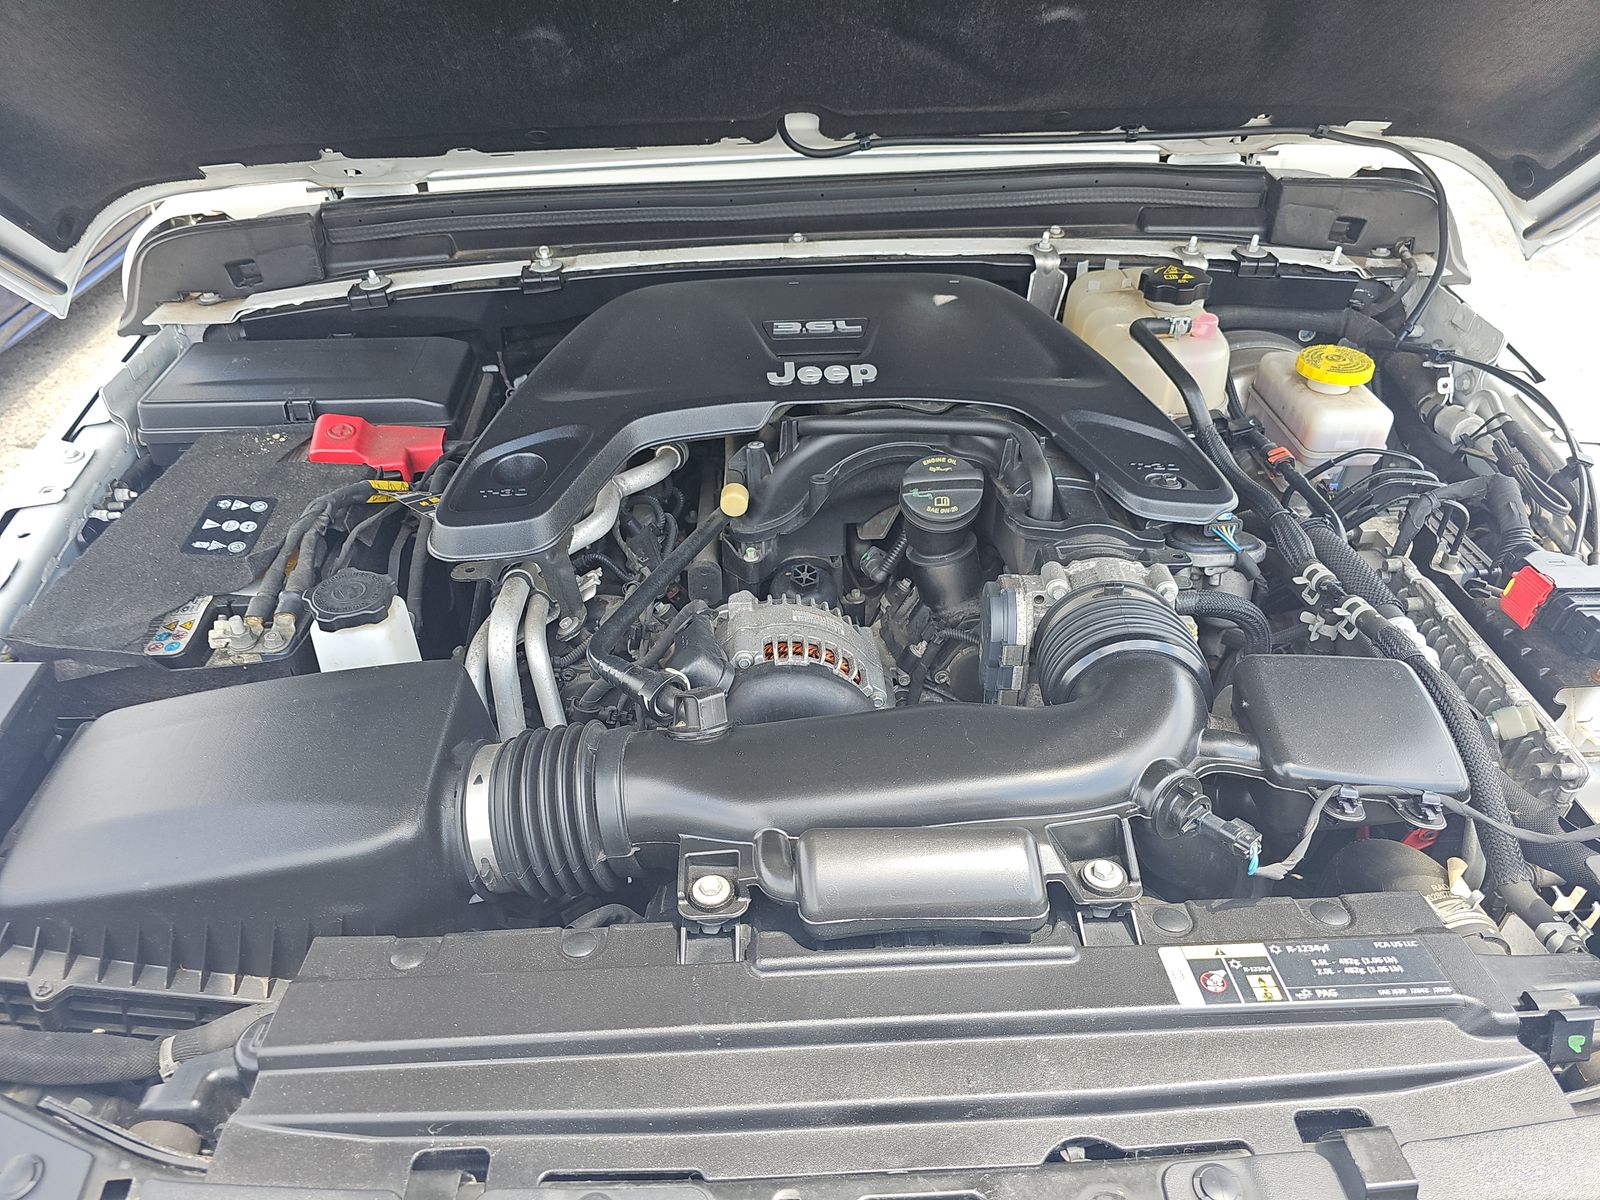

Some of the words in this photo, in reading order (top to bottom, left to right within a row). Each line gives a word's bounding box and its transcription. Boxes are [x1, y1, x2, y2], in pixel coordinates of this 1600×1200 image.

[773, 320, 862, 334] 3.6L
[766, 361, 878, 386] Jeep
[922, 457, 946, 466] ENGINE
[947, 457, 957, 466] OIL
[926, 505, 939, 514] SAE
[1285, 943, 1331, 954] R-1234yf
[1314, 988, 1339, 998] PAG
